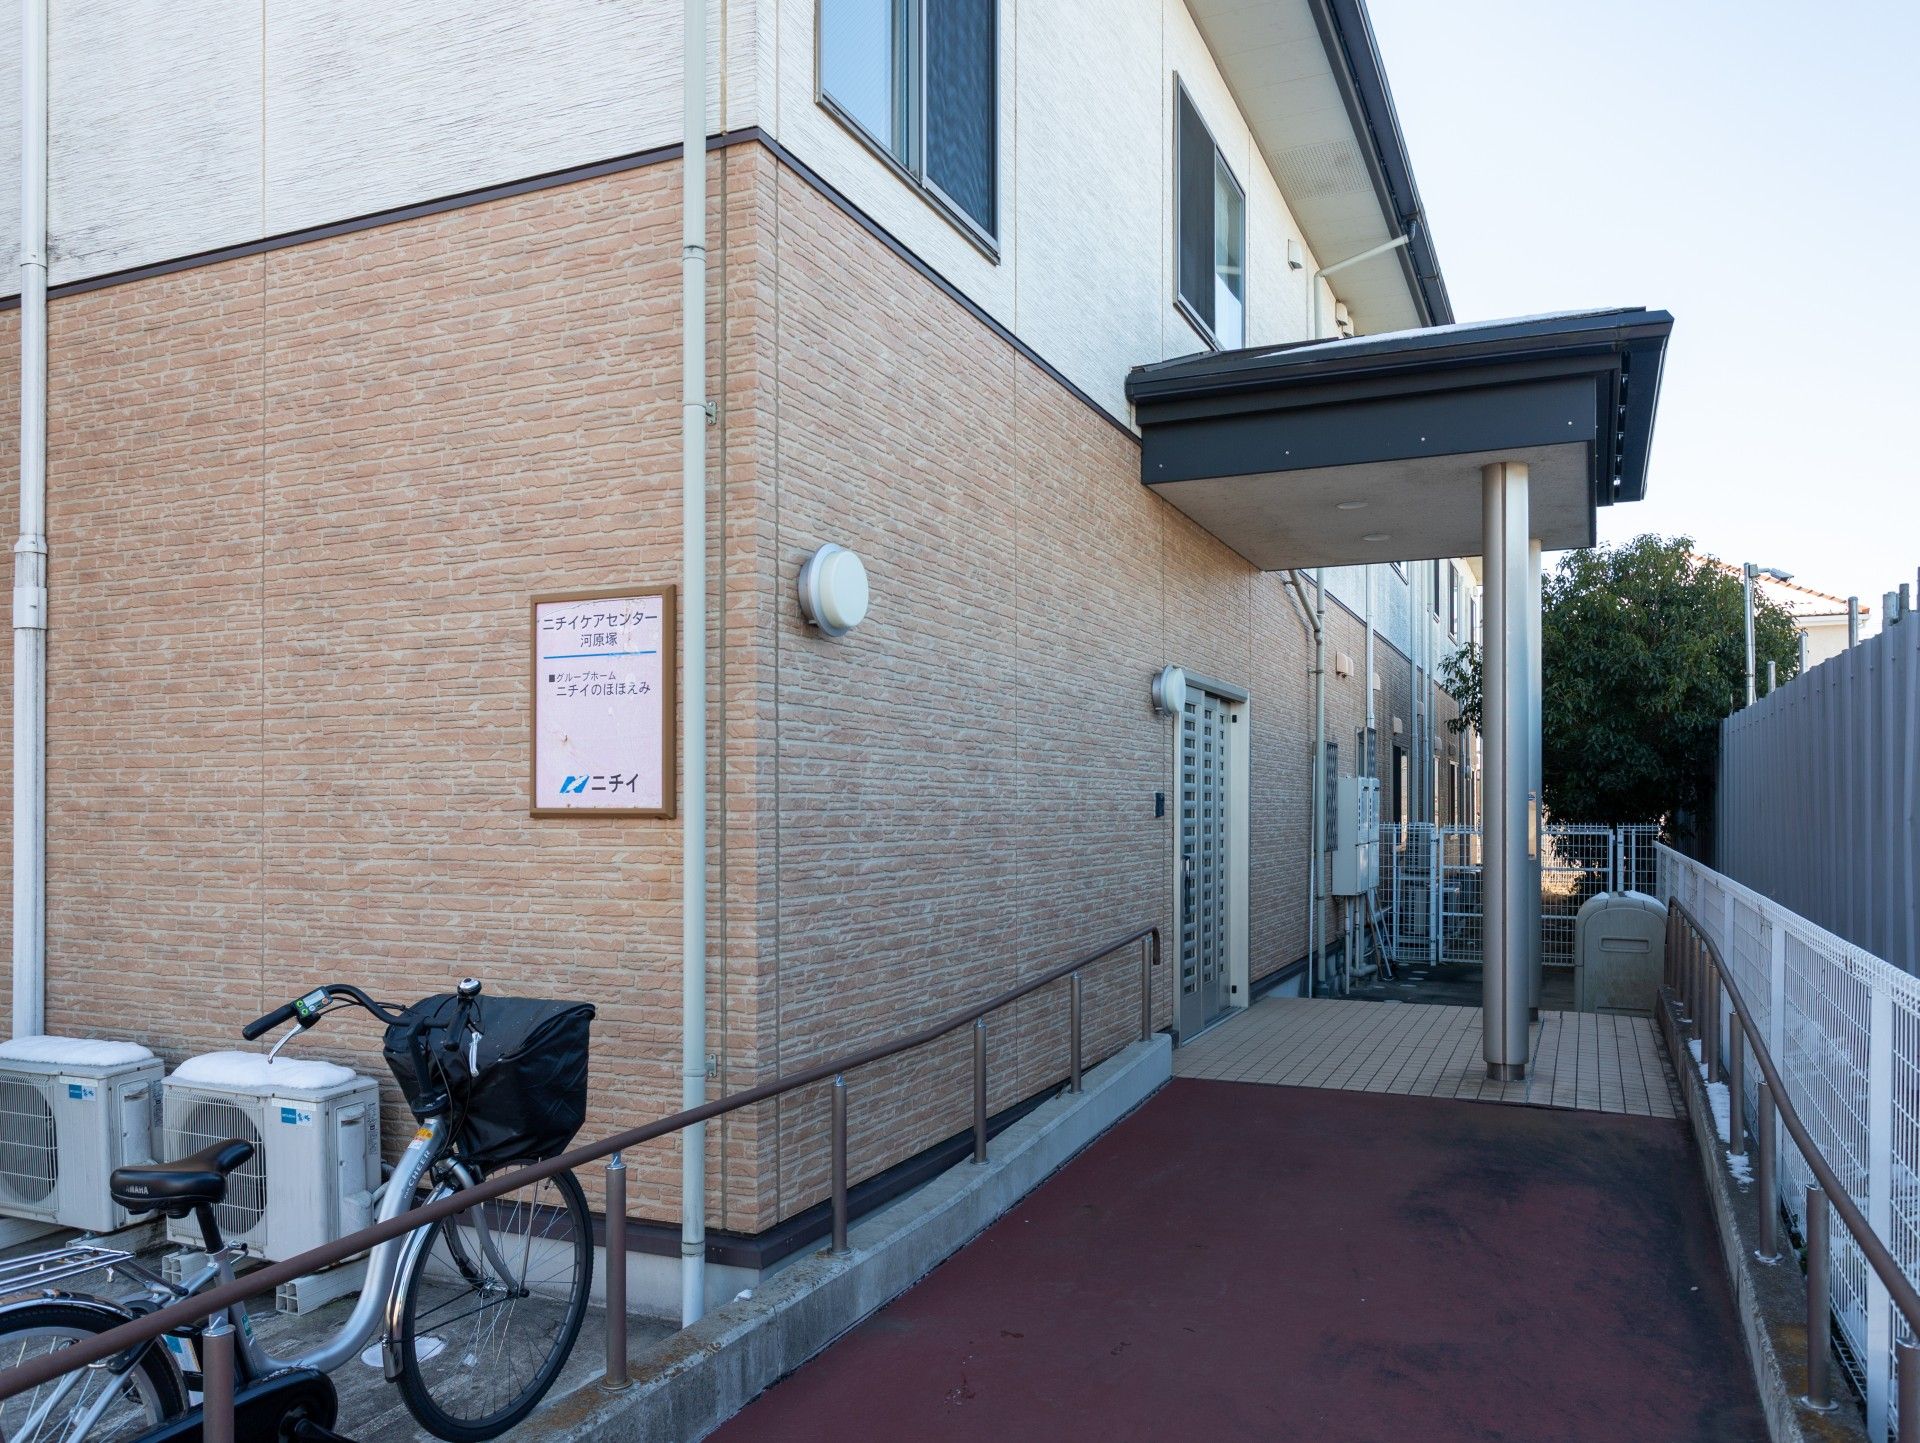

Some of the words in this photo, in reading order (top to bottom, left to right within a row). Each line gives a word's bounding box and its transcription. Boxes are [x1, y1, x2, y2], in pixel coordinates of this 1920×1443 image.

[543, 611, 657, 630] ニチイケアセンター
[580, 632, 617, 647] 河原塚
[557, 681, 651, 697] ニチイのほほえみ
[591, 773, 639, 793] ニチイ
[408, 1150, 431, 1187] CHEER
[122, 1184, 149, 1195] AMAHA
